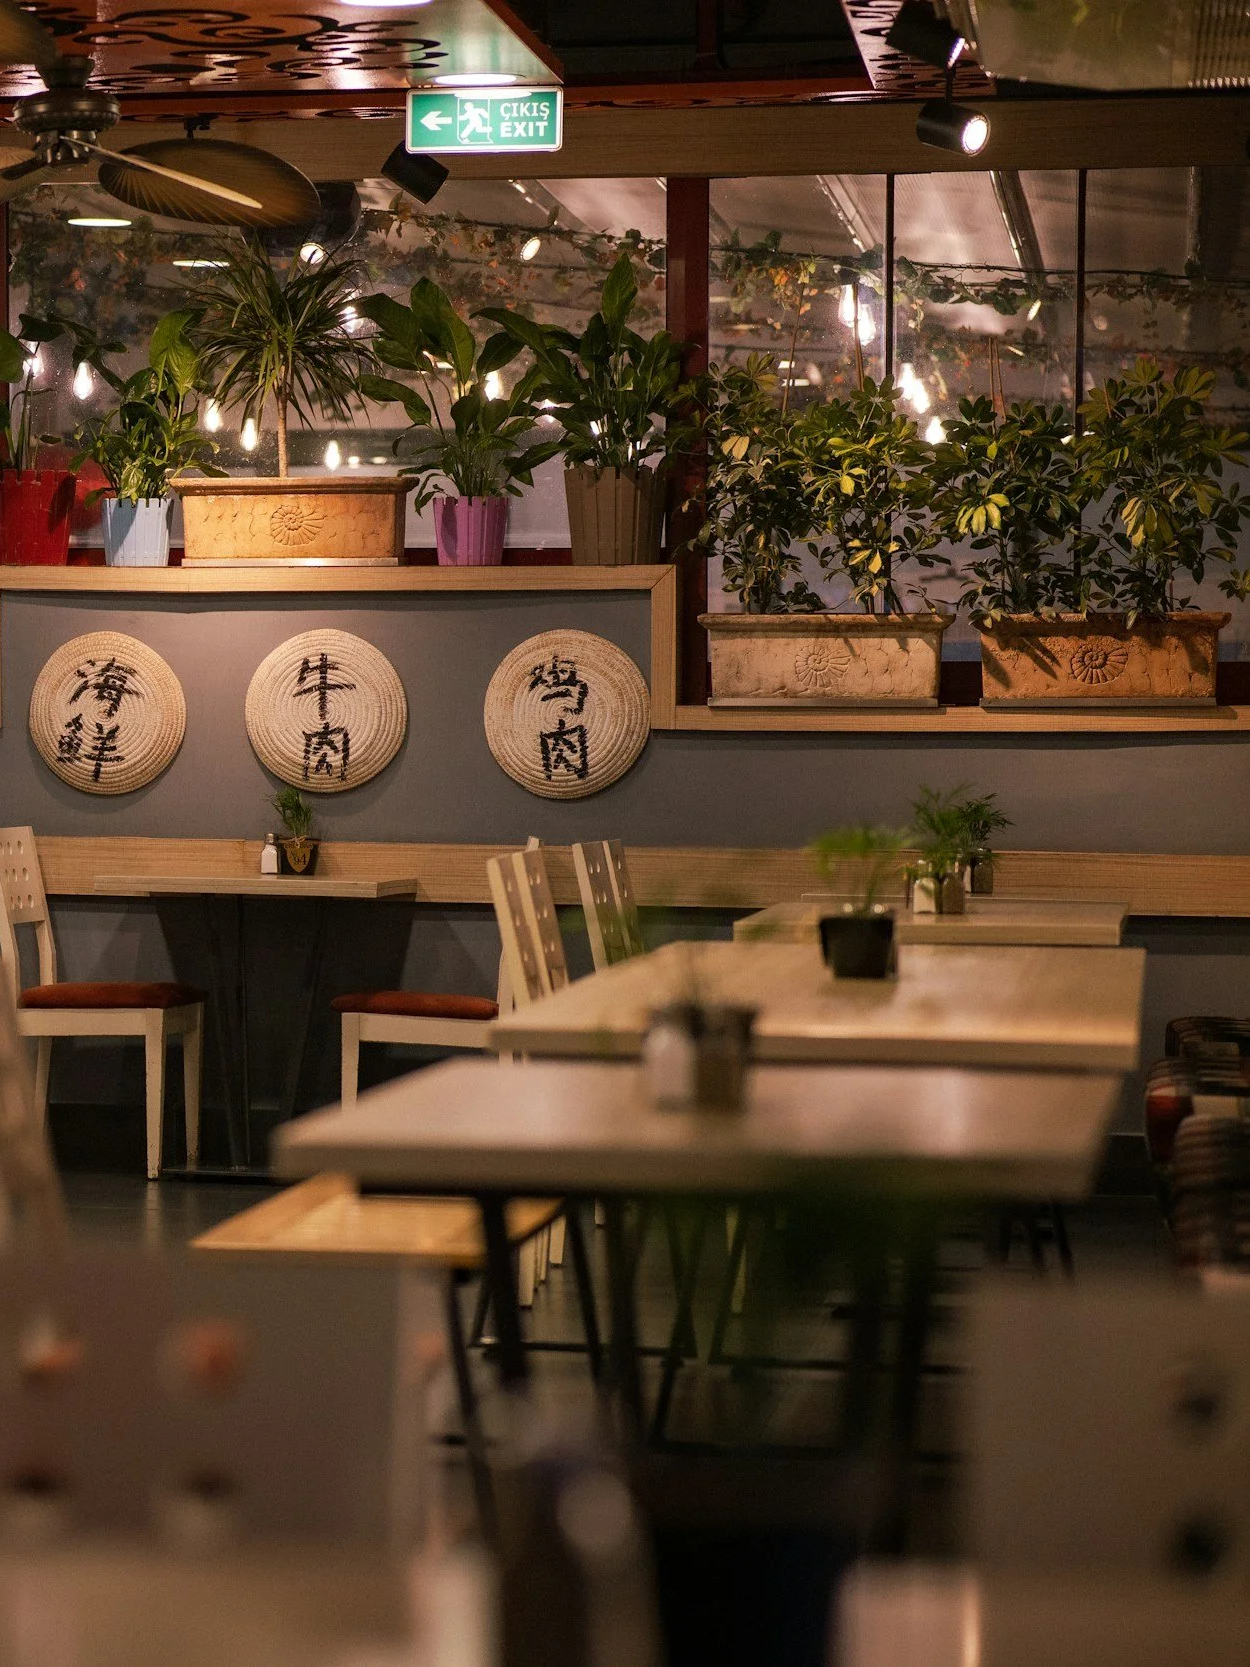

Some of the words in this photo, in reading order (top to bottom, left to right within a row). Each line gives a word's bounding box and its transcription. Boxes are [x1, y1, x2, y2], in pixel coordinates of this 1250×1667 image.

[500, 102, 550, 120] ÇIKIŞ
[500, 122, 549, 137] EXIT
[293, 653, 356, 782] 牛肉
